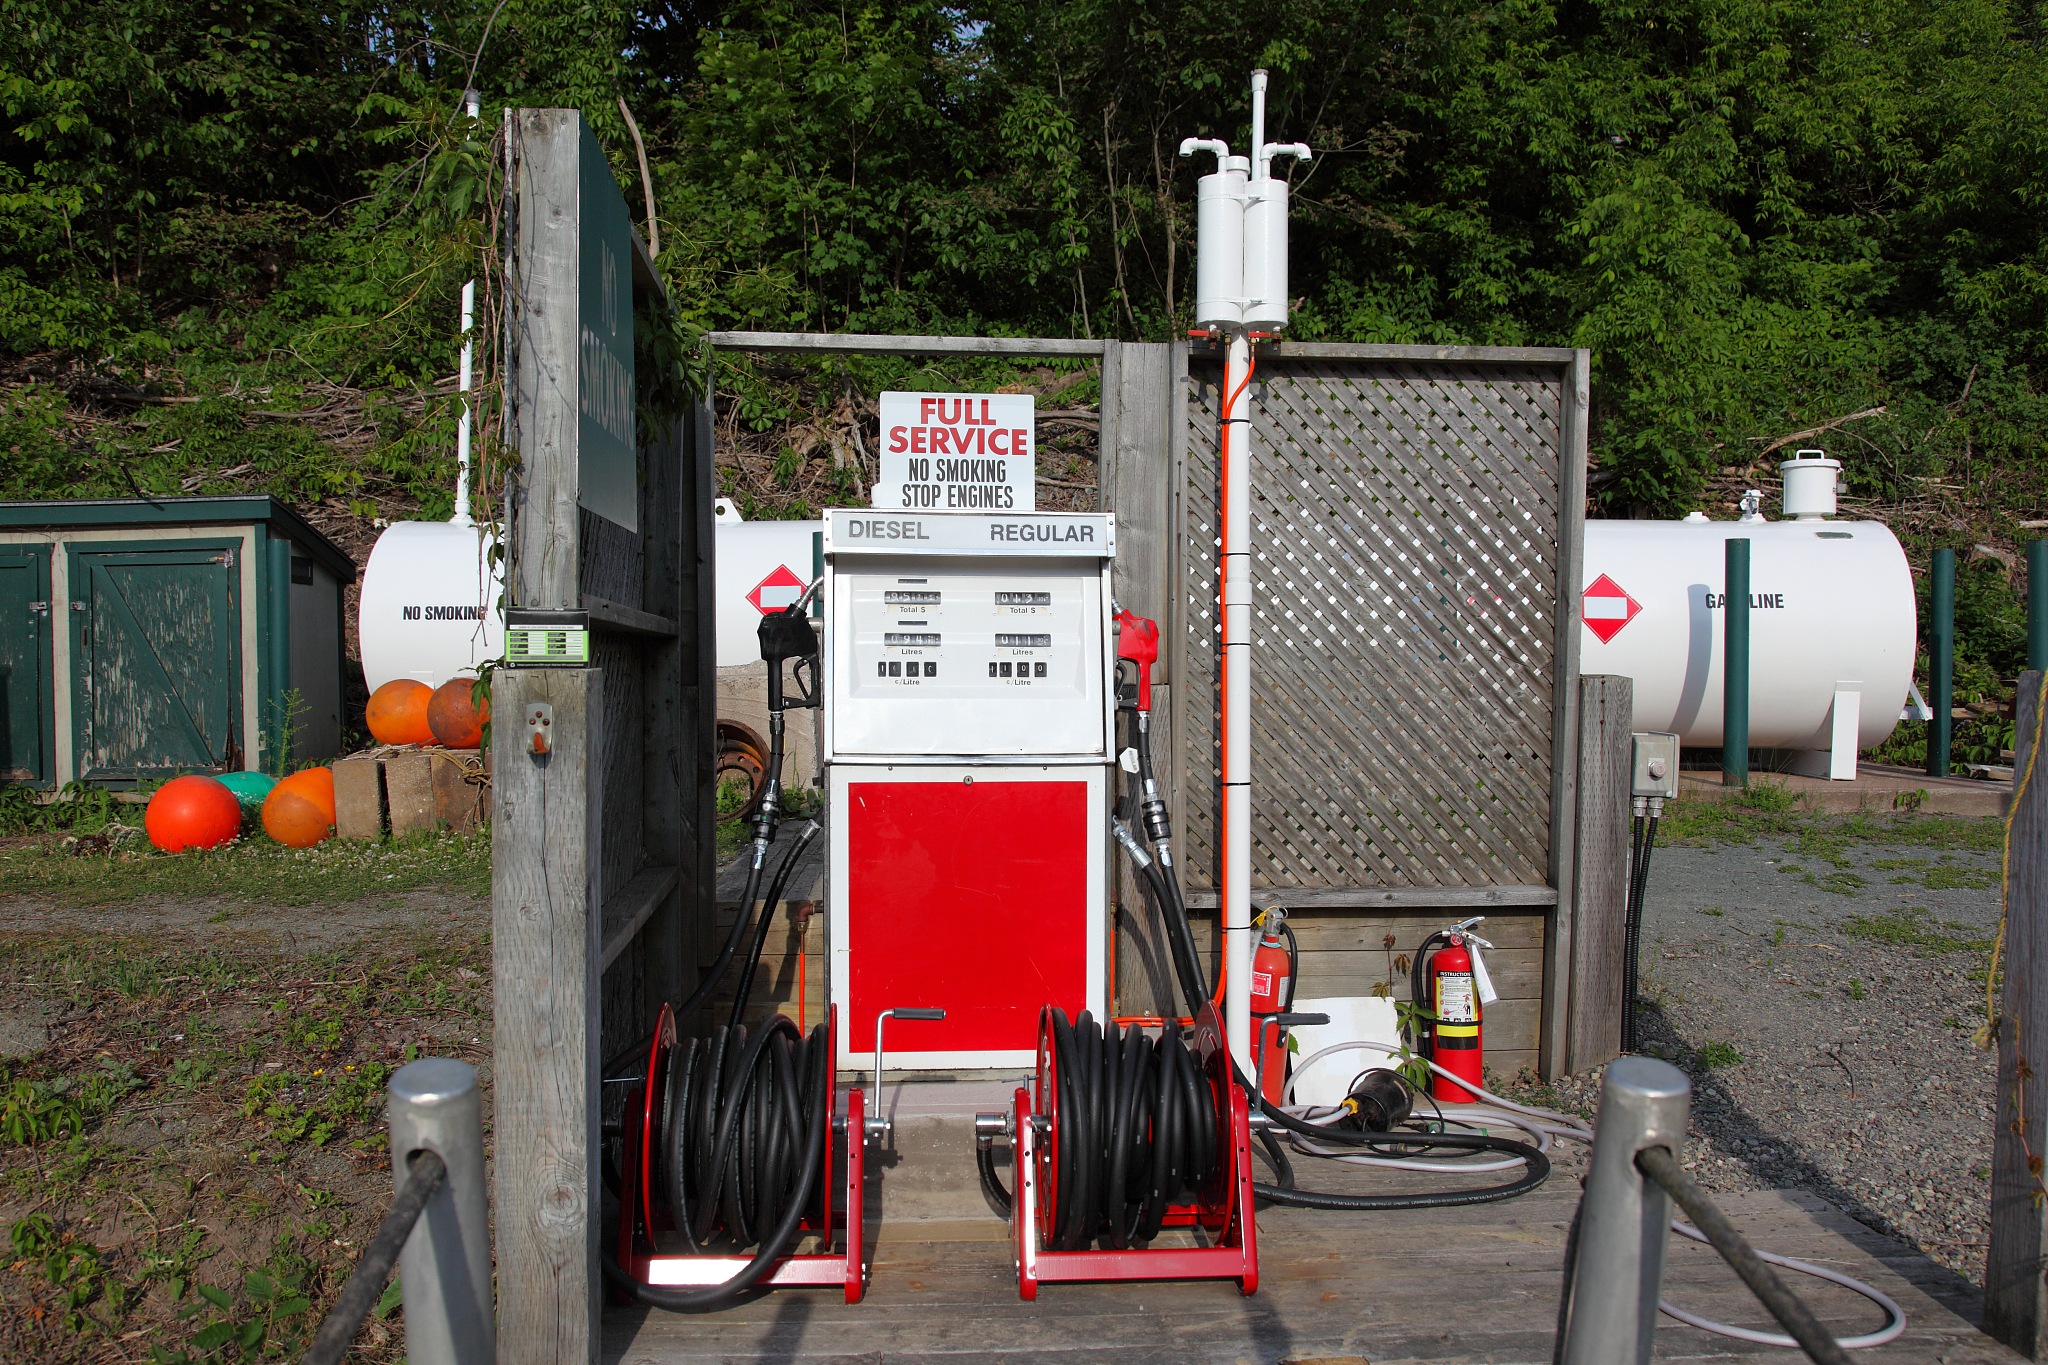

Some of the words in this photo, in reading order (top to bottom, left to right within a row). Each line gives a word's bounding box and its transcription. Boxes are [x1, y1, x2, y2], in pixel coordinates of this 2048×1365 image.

[601, 238, 618, 337] NO
[581, 323, 635, 451] SMOKING
[920, 397, 997, 426] FULL
[888, 425, 1028, 456] SERVICE
[908, 458, 930, 482] NO
[936, 458, 1006, 483] SMOKING
[902, 484, 941, 508] STOP
[947, 485, 1014, 509] ENGINES
[848, 519, 930, 540] DIESEL
[990, 523, 1095, 542] REGULAR
[1010, 606, 1028, 614] Total
[1705, 593, 1785, 609] GALINE
[402, 605, 421, 620] NO
[424, 605, 486, 621] SMOKING
[1012, 648, 1034, 656] Litres
